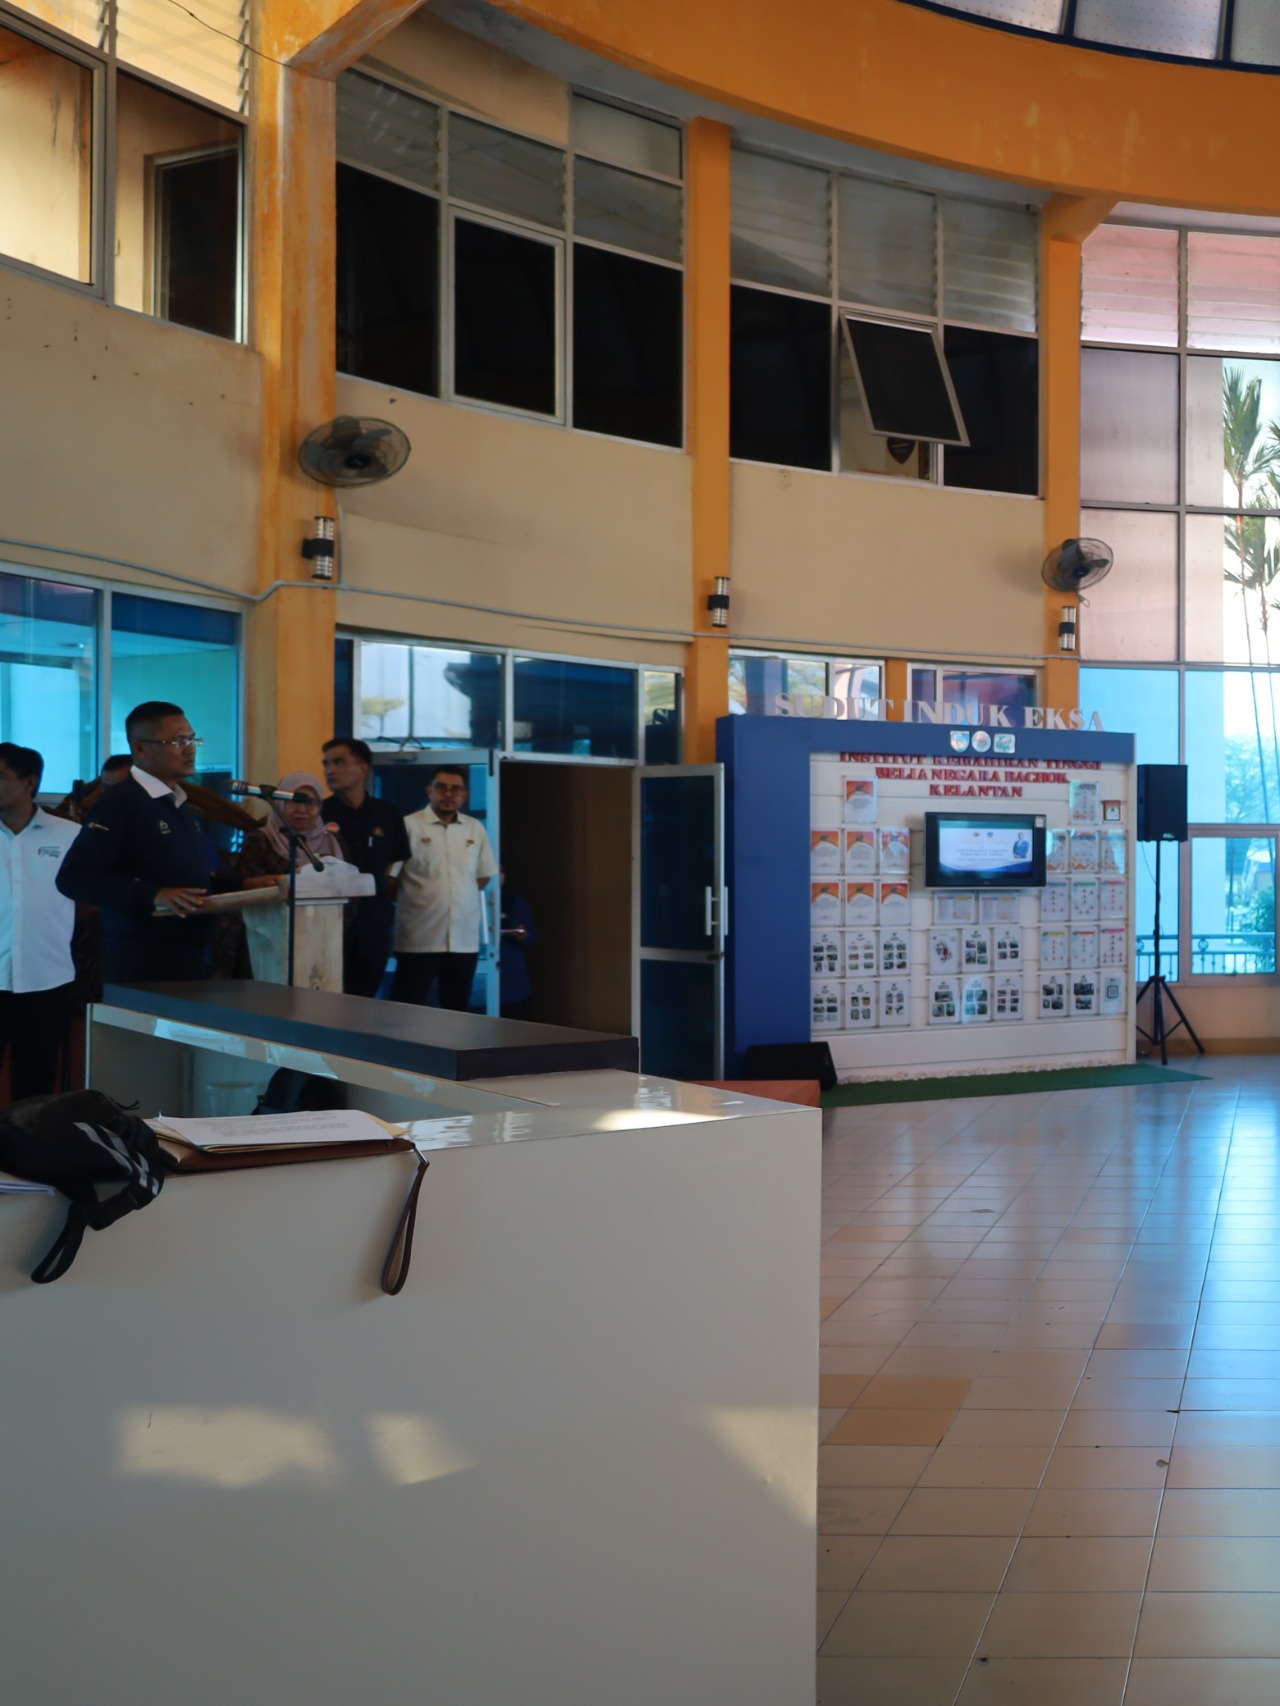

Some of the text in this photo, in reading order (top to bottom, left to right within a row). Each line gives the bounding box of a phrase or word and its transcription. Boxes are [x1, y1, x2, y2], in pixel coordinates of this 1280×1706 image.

[774, 692, 1105, 732] SUDUT INDUK EKSA
[931, 768, 1000, 782] NEGARA
[929, 784, 1023, 798] KELANTAN
